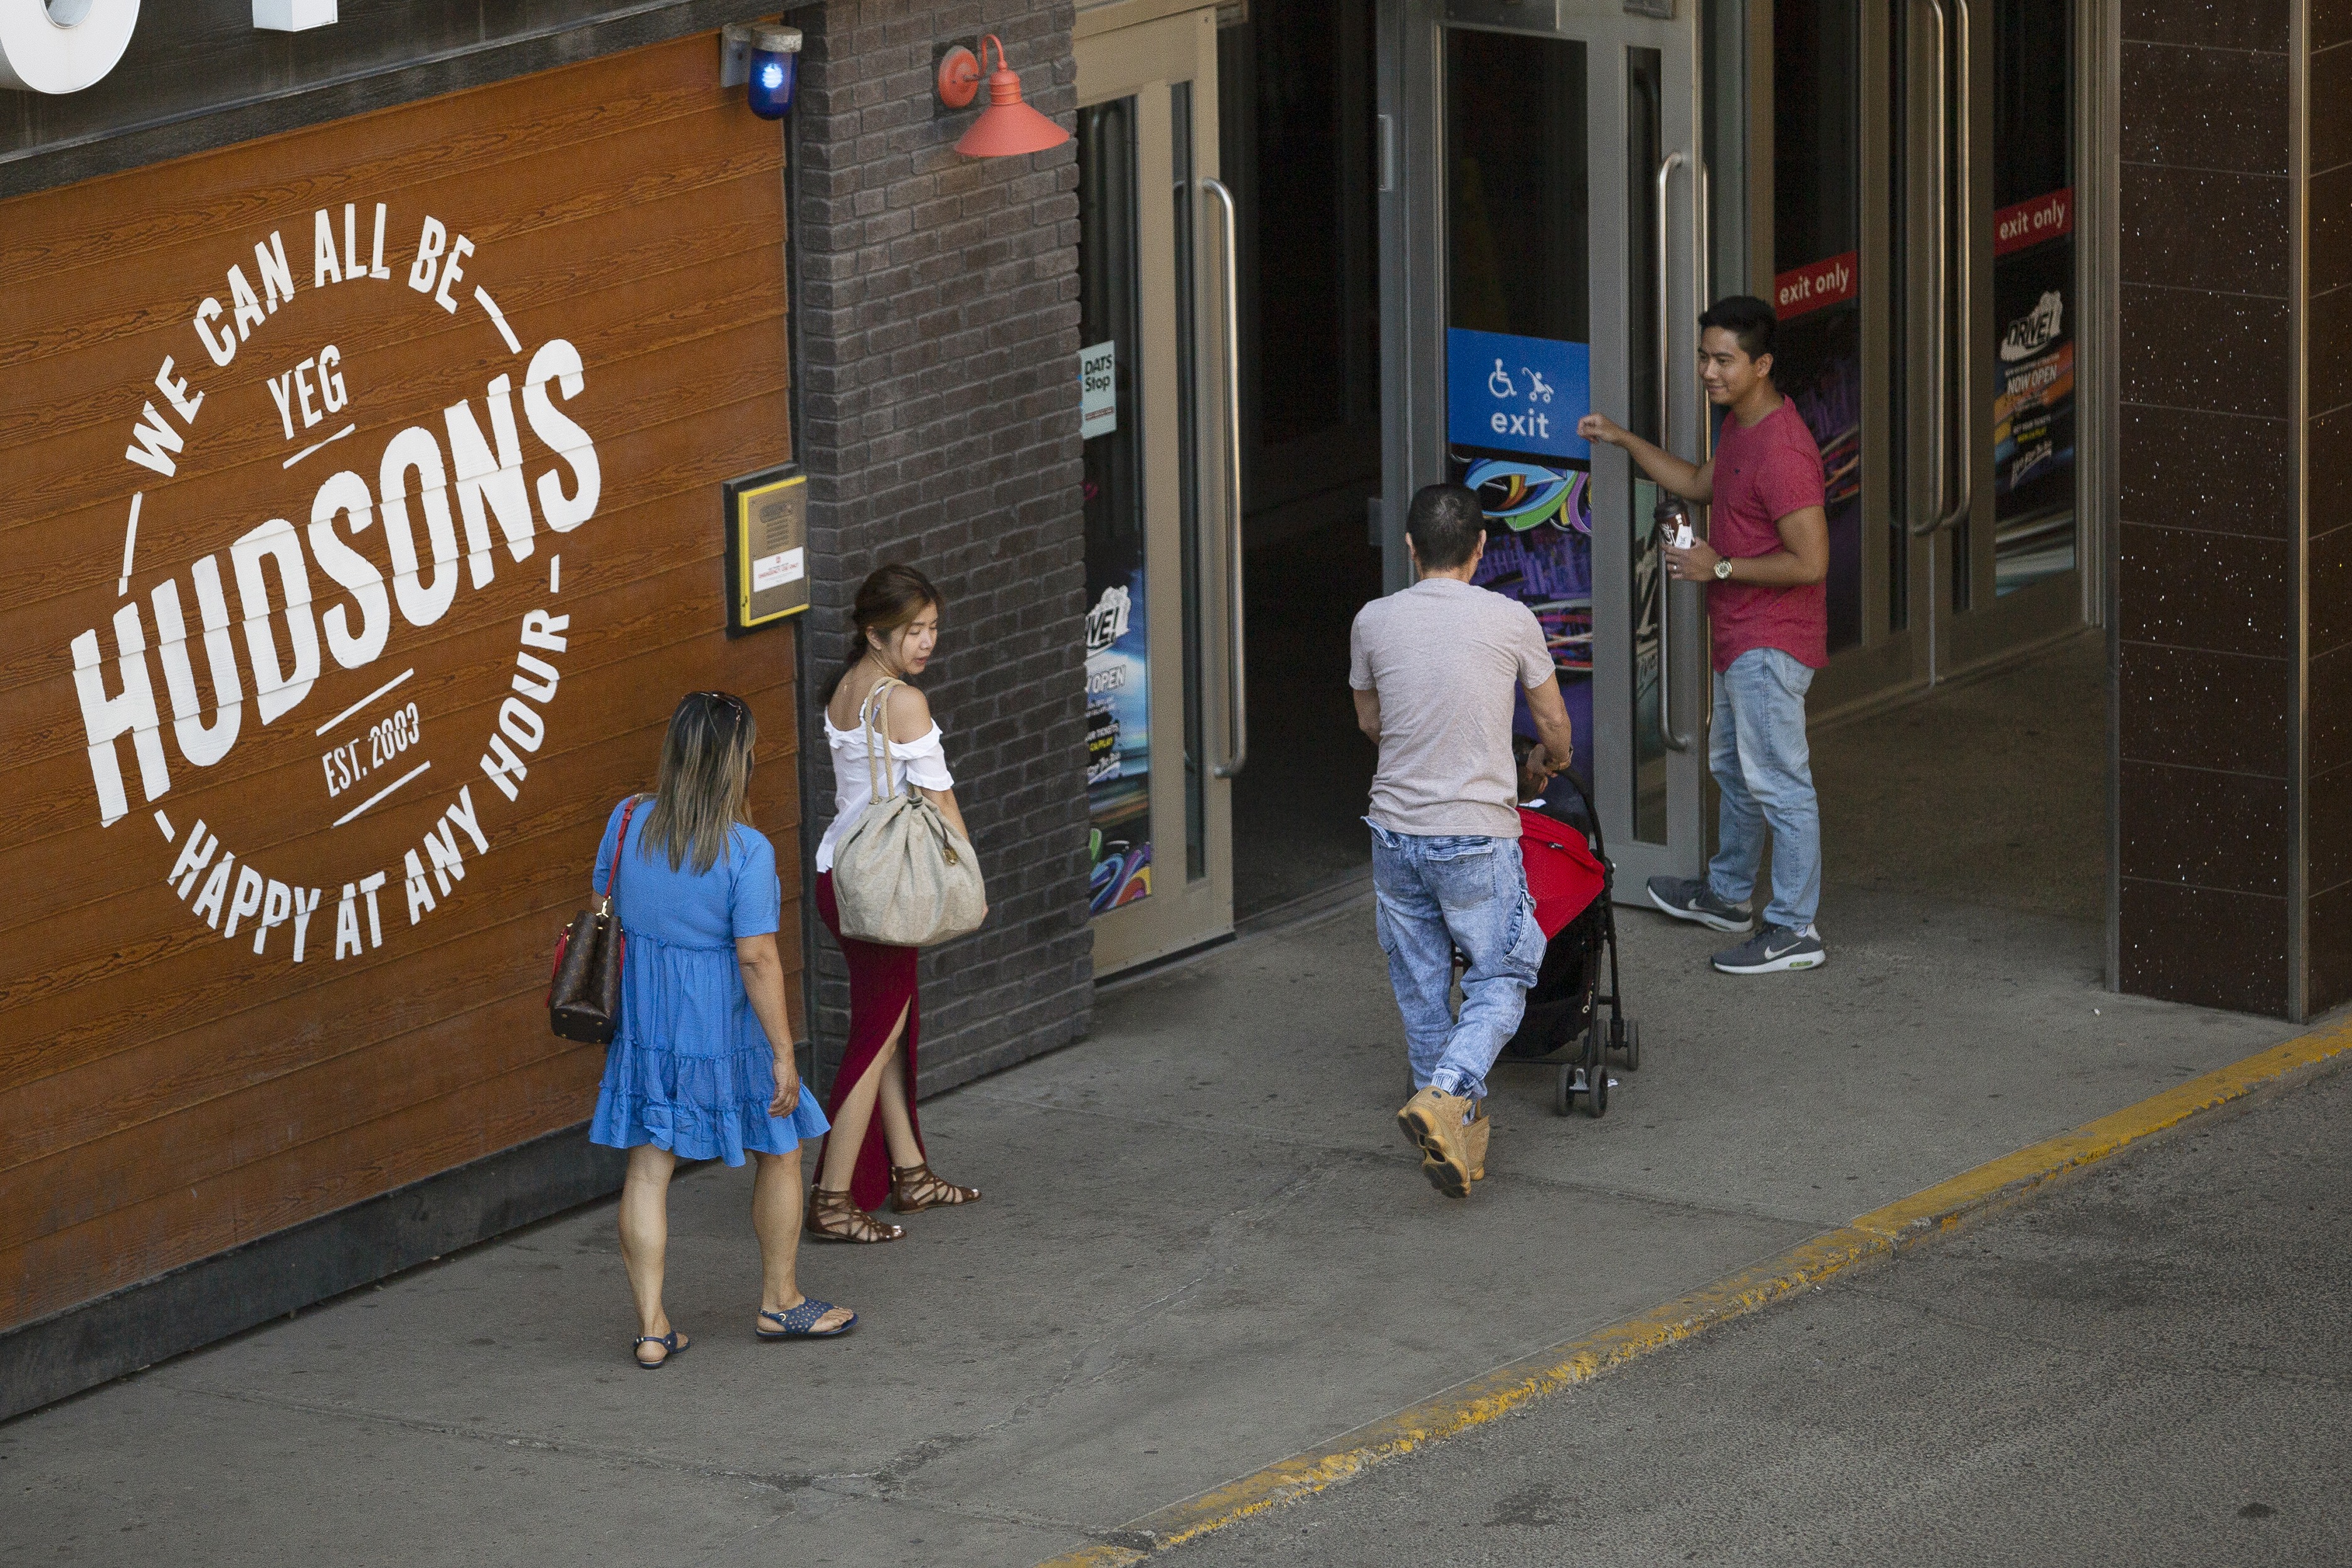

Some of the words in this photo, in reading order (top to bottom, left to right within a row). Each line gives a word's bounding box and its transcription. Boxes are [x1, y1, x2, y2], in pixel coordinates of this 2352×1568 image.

[1999, 210, 2028, 241] exit
[2033, 198, 2066, 233] only
[1780, 275, 1810, 305] exit
[1816, 263, 1850, 294] only
[125, 354, 205, 477] WE
[193, 230, 295, 367] CAN
[314, 202, 391, 289] ALL
[408, 215, 475, 315] BE
[1084, 354, 1113, 375] DATS
[1085, 375, 1111, 392] Stop
[2007, 371, 2030, 395] NOW
[2032, 364, 2057, 387] OPEN
[266, 344, 349, 440] YEG
[1491, 408, 1550, 439] exit
[70, 338, 601, 829] HUDSONS
[1093, 664, 1126, 694] OPEN
[322, 738, 368, 798] EST.
[368, 702, 420, 769] 2003
[167, 818, 322, 963] HAPPY
[335, 871, 386, 961] AT
[404, 785, 489, 926] ANY
[479, 609, 570, 802] HOUR
